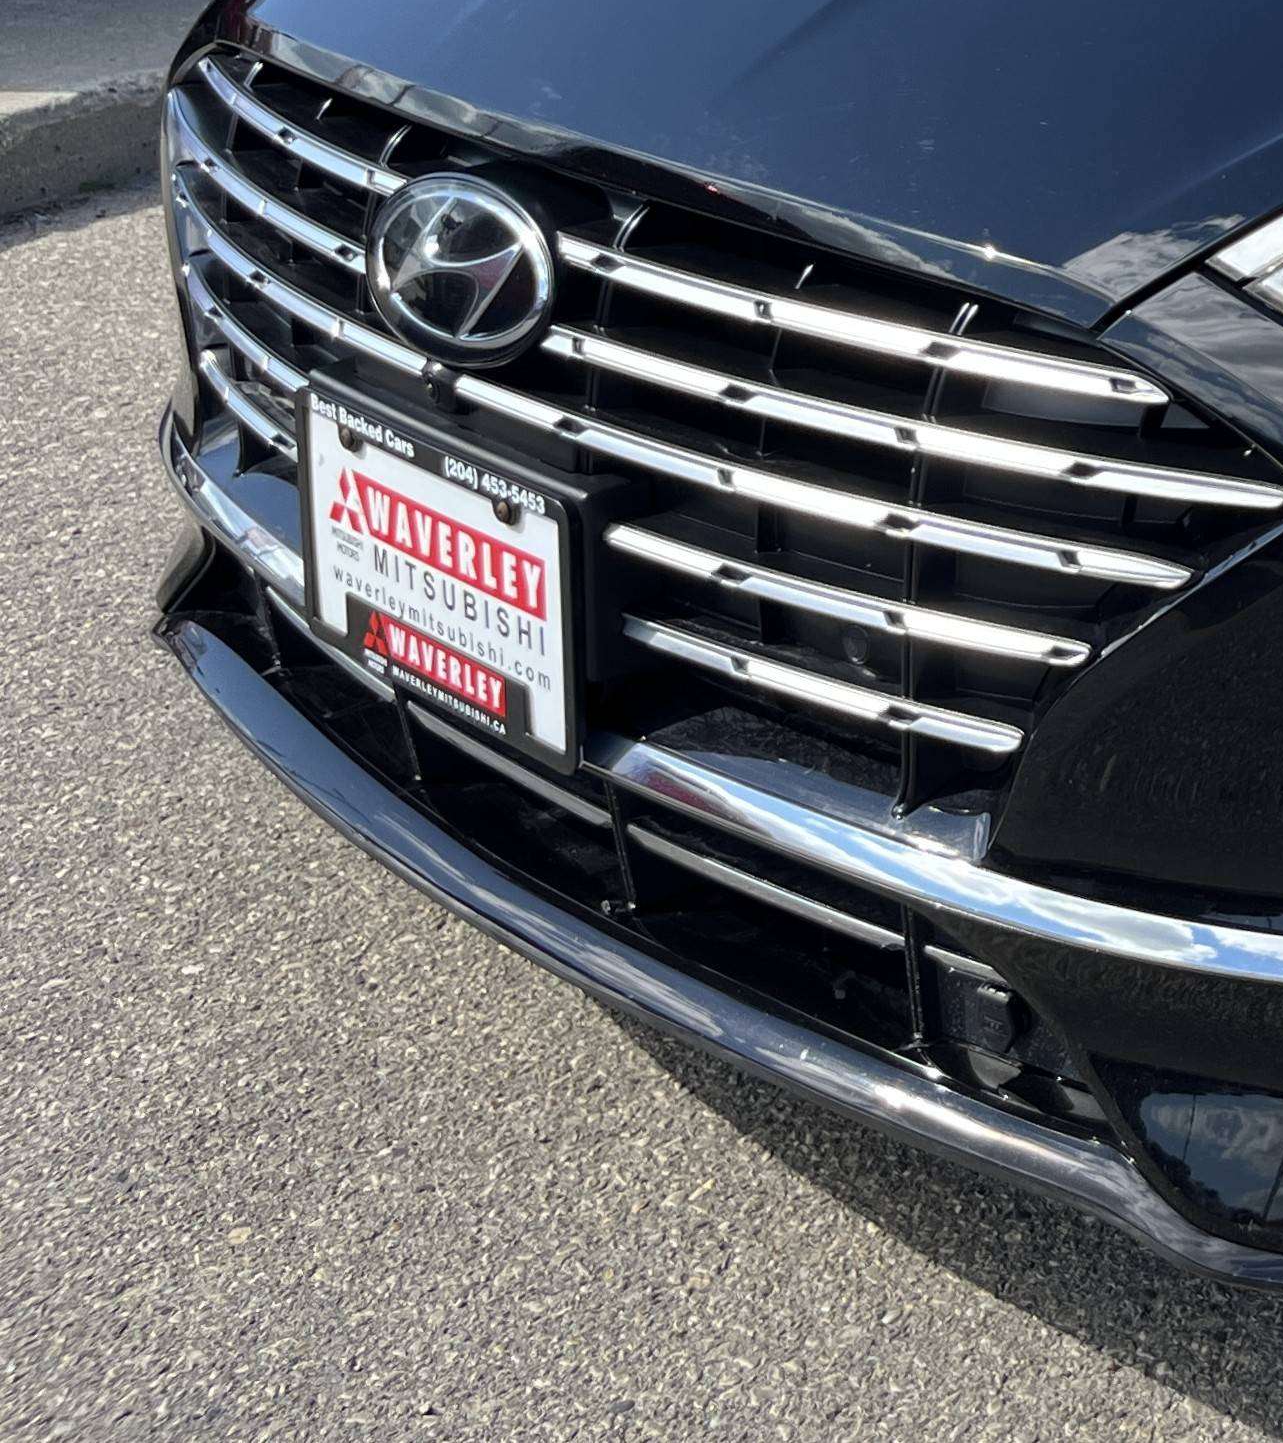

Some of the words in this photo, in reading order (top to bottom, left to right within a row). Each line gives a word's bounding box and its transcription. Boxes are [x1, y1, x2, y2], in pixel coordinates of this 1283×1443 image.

[309, 392, 338, 421] Best
[338, 407, 384, 444] Backed
[385, 430, 415, 458] Cars
[443, 455, 479, 490] (204)
[481, 473, 546, 515] 453-5453
[366, 485, 542, 609] WAVERLEY
[332, 565, 552, 691] waverleymitsubishi.com
[373, 544, 546, 656] MITSUBISHI
[388, 623, 503, 710] WAVERLEY
[391, 662, 507, 736] WAVERLEYMITSUBISHI.CA
